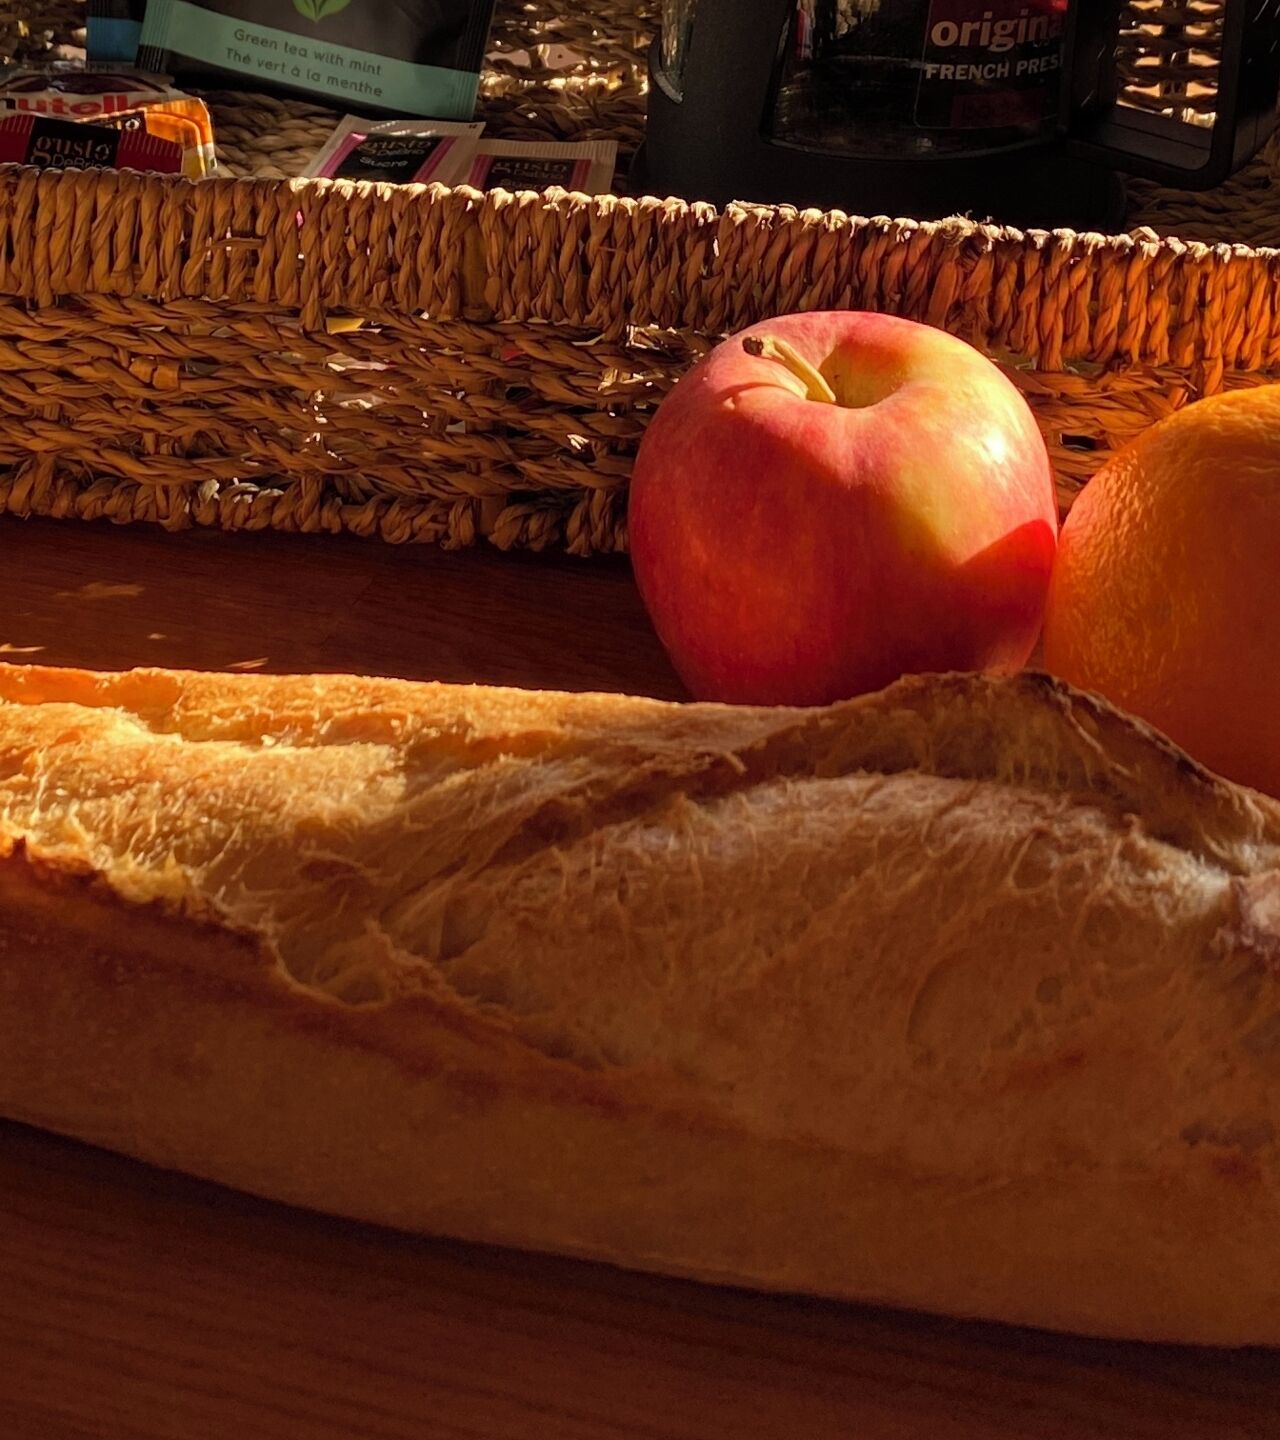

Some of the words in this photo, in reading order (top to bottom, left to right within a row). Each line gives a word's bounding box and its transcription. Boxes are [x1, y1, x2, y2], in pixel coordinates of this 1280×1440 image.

[234, 28, 278, 51] Green
[284, 41, 308, 59] tea
[314, 47, 344, 67] with
[349, 55, 382, 76] mint
[926, 60, 1009, 80] FRENCH
[1016, 54, 1063, 78] PRES
[226, 48, 251, 67] Thé
[257, 57, 286, 75] vert
[291, 63, 302, 78] à
[307, 67, 321, 82] la
[326, 75, 383, 98] menthe
[360, 156, 408, 168] Sucre
